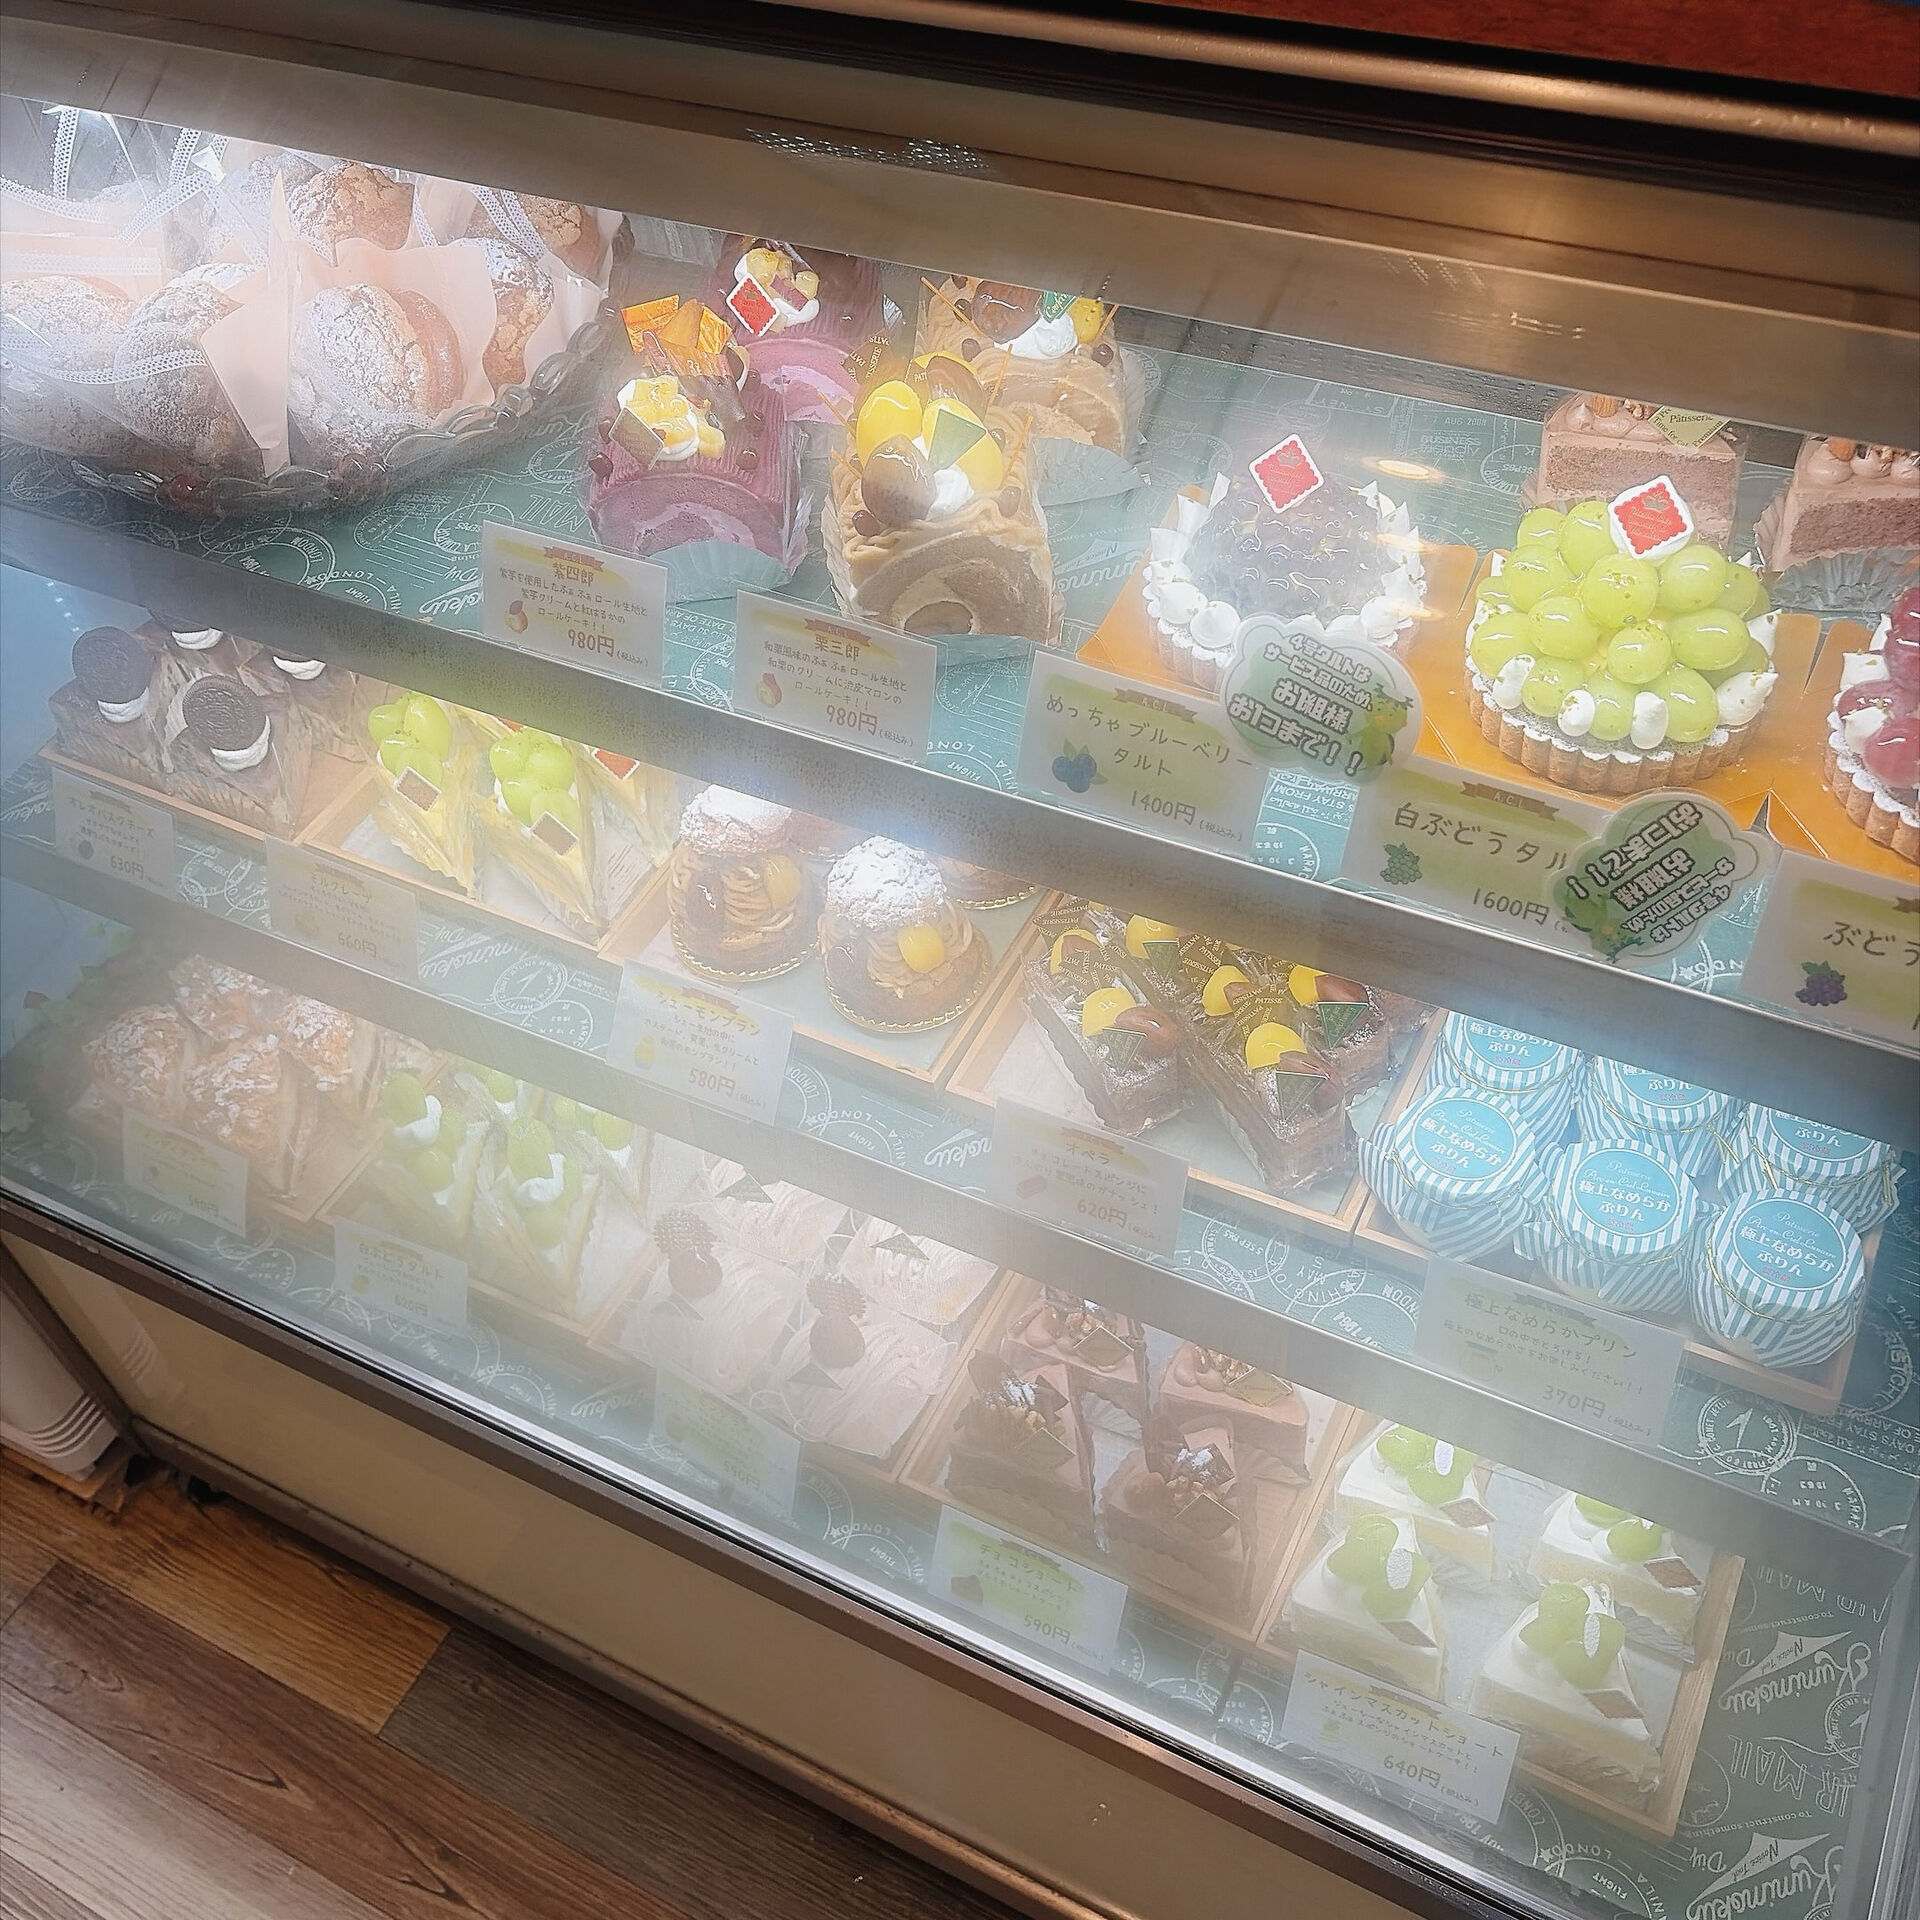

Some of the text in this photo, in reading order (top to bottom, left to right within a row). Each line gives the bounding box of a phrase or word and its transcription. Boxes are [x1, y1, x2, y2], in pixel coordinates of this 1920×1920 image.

[552, 562, 594, 587] 紫四郎
[568, 628, 615, 658] 980円
[815, 635, 860, 662] 栗三郎
[1287, 632, 1373, 684] 4号タルトは
[826, 705, 878, 735] 980円
[1045, 694, 1254, 767] めっちゃブルーベリー
[1113, 746, 1173, 778] タルト
[1131, 790, 1198, 826] 1400円
[1274, 784, 1311, 800] FROM
[1393, 802, 1567, 870] 白ぶどうタル
[110, 855, 144, 880] 630円
[1471, 887, 1550, 927] 1600円
[1650, 884, 1732, 944] 4号タルトは
[656, 991, 761, 1036] シューモンブラン
[688, 1068, 735, 1097] 580円
[1066, 1142, 1111, 1165] オペラ
[1421, 1117, 1502, 1166] 極上なめらか
[1578, 1180, 1671, 1212] 極上なめらか
[1077, 1198, 1128, 1229] 620円
[1740, 1226, 1835, 1272] 極上なめらか
[1463, 1291, 1638, 1361] 極上なめらかプリン
[1541, 1384, 1607, 1420] 370円
[979, 1543, 1081, 1593] チョコショート
[1022, 1614, 1071, 1644] 590円
[1302, 1672, 1505, 1758] シャインマスカットショート
[1382, 1754, 1441, 1788] 640円
[1728, 1735, 1808, 1801] MAIL
[1744, 1813, 1798, 1831] construct
[1688, 1848, 1727, 1874] Diy
[1592, 1871, 1628, 1899] FLIGHT
